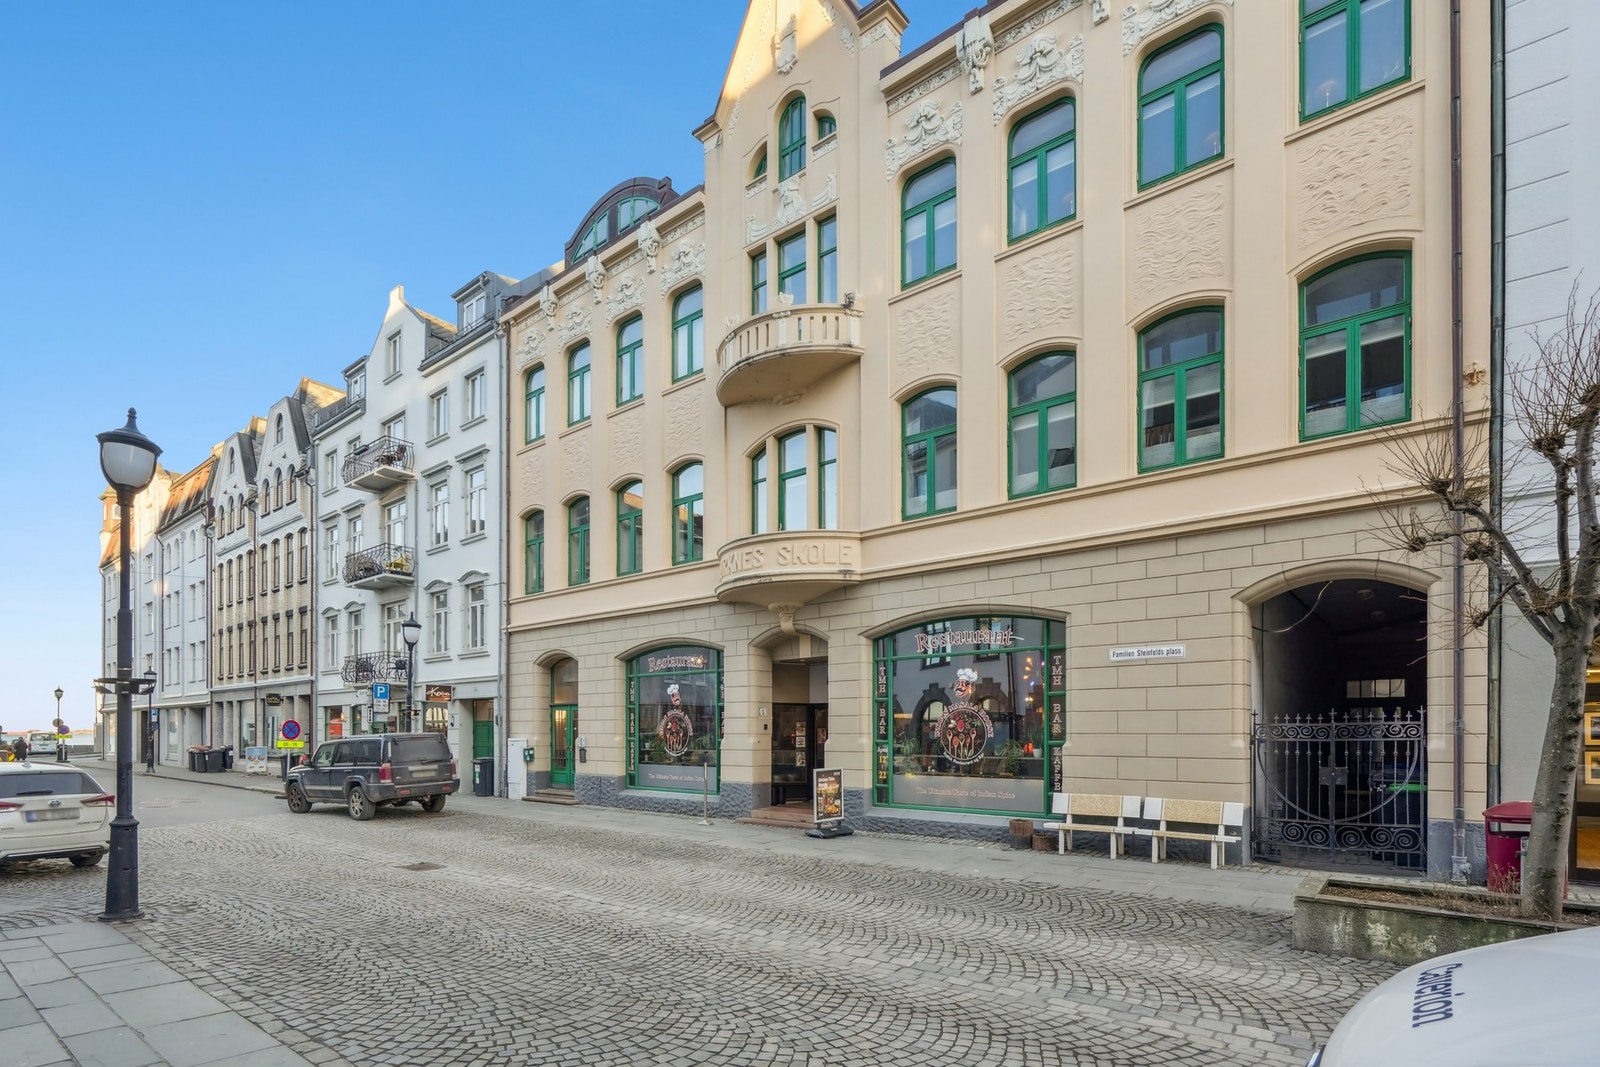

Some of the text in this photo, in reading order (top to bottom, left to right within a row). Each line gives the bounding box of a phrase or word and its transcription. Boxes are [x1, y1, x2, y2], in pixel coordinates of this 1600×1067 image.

[776, 543, 852, 566] SKOLE
[915, 627, 1013, 653] Restaurant
[647, 654, 704, 672] Restaurant
[1112, 647, 1182, 658] Familien Steinfelds plass
[878, 666, 887, 693] TMH
[1051, 655, 1063, 686] TMH
[376, 686, 386, 698] P
[879, 708, 887, 735] BAR
[1052, 703, 1063, 734] BAR
[879, 770, 887, 779] 22
[915, 786, 927, 794] The
[1411, 963, 1465, 1029] Caverion
